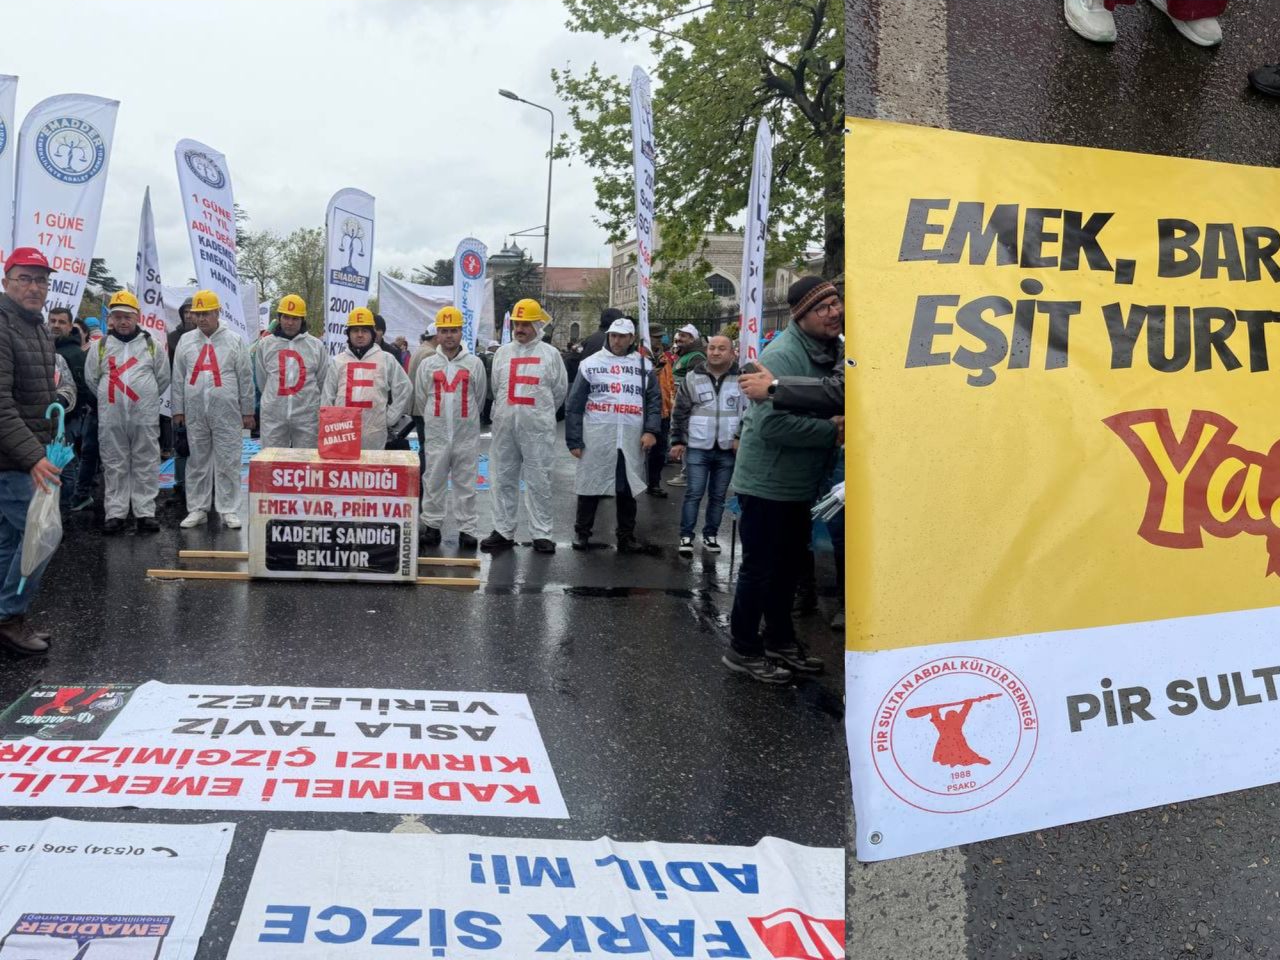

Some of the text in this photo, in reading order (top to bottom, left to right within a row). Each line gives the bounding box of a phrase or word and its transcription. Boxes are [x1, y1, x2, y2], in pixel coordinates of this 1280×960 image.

[192, 194, 232, 221] 1 GÜNE
[34, 211, 84, 231] 1 GÜNE
[192, 220, 214, 237] ADİL
[202, 210, 229, 232] 17 YIL
[38, 232, 76, 250] 17 YIL
[898, 198, 1135, 285] EMEK,
[53, 256, 87, 276] DEĞİL
[332, 270, 367, 285] EMADDER
[196, 298, 204, 308] A
[287, 301, 296, 311] D
[516, 306, 525, 318] E
[356, 313, 364, 323] E
[443, 313, 453, 323] M
[904, 278, 1082, 387] EŞİT
[189, 343, 223, 388] A
[277, 349, 306, 396] D
[610, 365, 633, 376] 43 YAŞ
[108, 355, 140, 404] K
[345, 362, 377, 408] E
[507, 357, 541, 406] E
[621, 384, 634, 396] YAŞ
[432, 369, 470, 419] M
[325, 421, 354, 433] OYUMUZ
[323, 433, 357, 446] ADALETE
[272, 465, 397, 491] SEÇİM SANDIĞI
[258, 499, 412, 518] EMEK VAR, PRİM VAR
[271, 525, 395, 545] KADEME SANDIĞI
[297, 546, 369, 567] BEKLİYOR
[401, 521, 411, 577] EMADDER
[187, 693, 499, 717] VERİLEMEZ.
[874, 660, 1036, 752] PİR SULTAN ABDAL KÜLTÜR DERNEĞİ
[1066, 677, 1156, 733] PİR
[171, 716, 498, 742] ASLA TAVİZ
[335, 750, 533, 775] KIRMIZI
[260, 778, 542, 806] KADEMELİ
[947, 781, 976, 792] PSAKD
[42, 844, 78, 853] 506
[85, 844, 145, 856] 0(534)
[469, 852, 759, 900] ADİL Mİ!
[16, 921, 168, 937] EMADDER
[258, 904, 750, 959] FARK SİZCE
